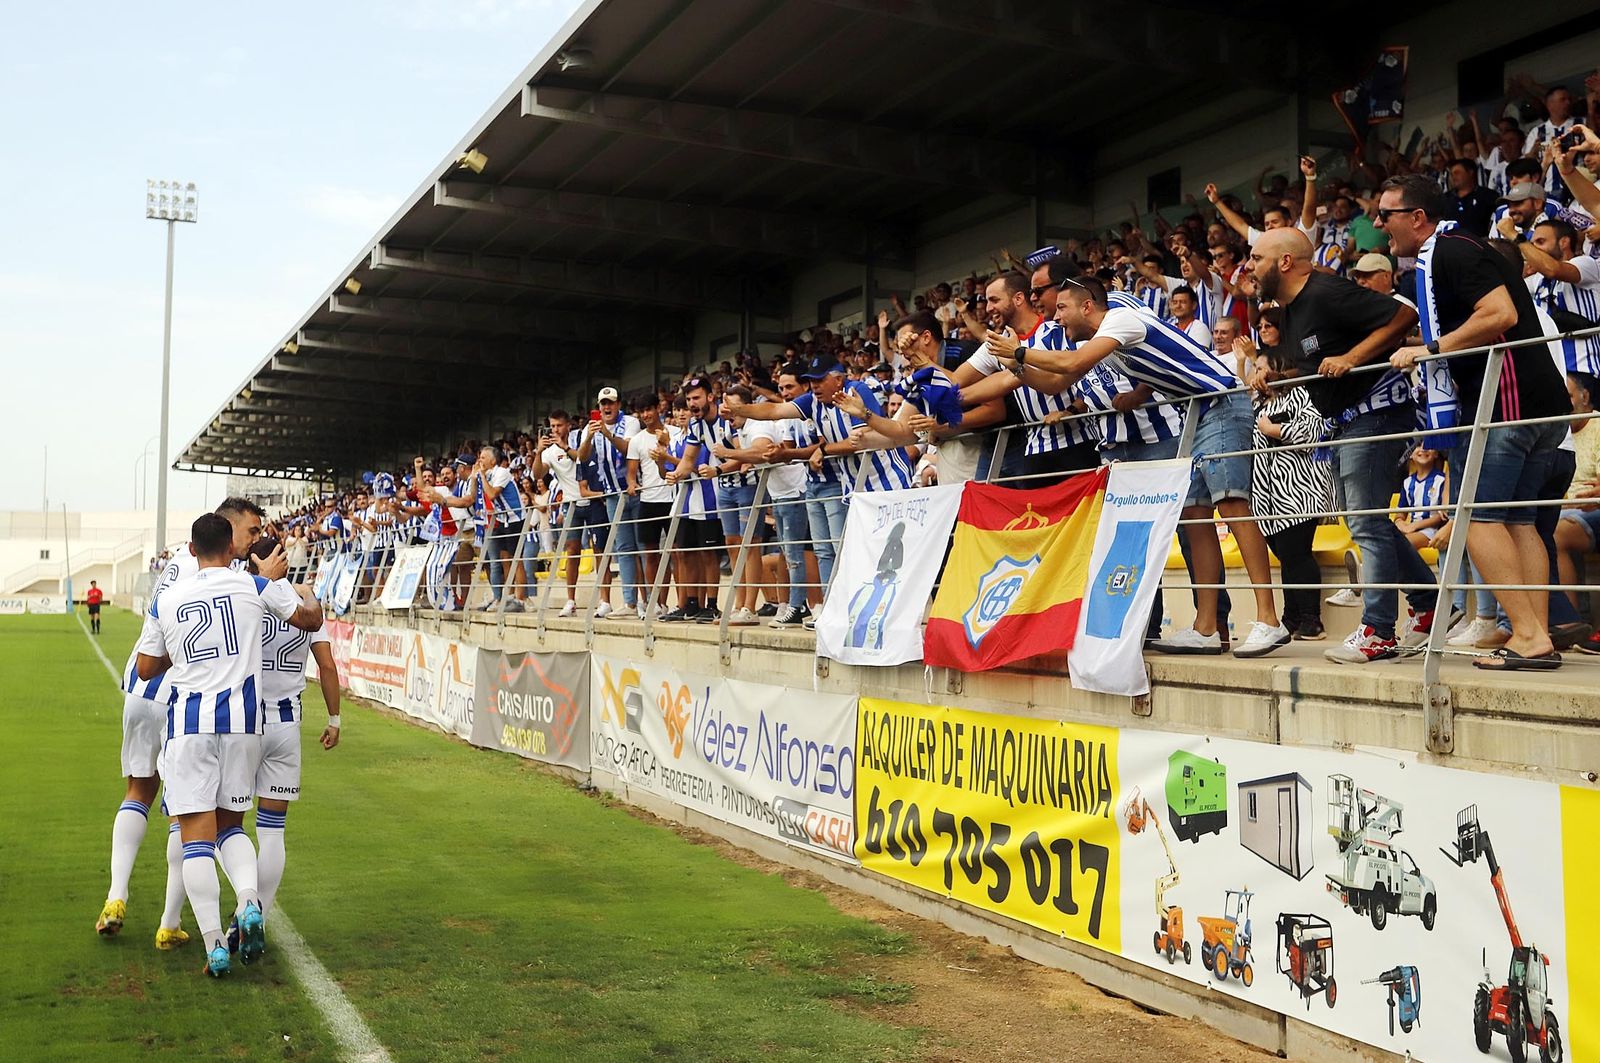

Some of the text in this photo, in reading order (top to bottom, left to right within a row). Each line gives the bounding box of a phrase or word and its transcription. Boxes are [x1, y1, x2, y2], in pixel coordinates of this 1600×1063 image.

[1106, 492, 1179, 507] Orgullo Onubene
[176, 595, 240, 664] 21
[497, 688, 553, 724] CRISAUTO
[692, 685, 854, 800] Vélez Alfonso
[861, 710, 1112, 819] ALQUILER DE MAQUINARIA
[660, 764, 714, 805] FERRETERIA
[721, 784, 775, 825] PINTURAS
[865, 785, 1110, 940] 610 705 017
